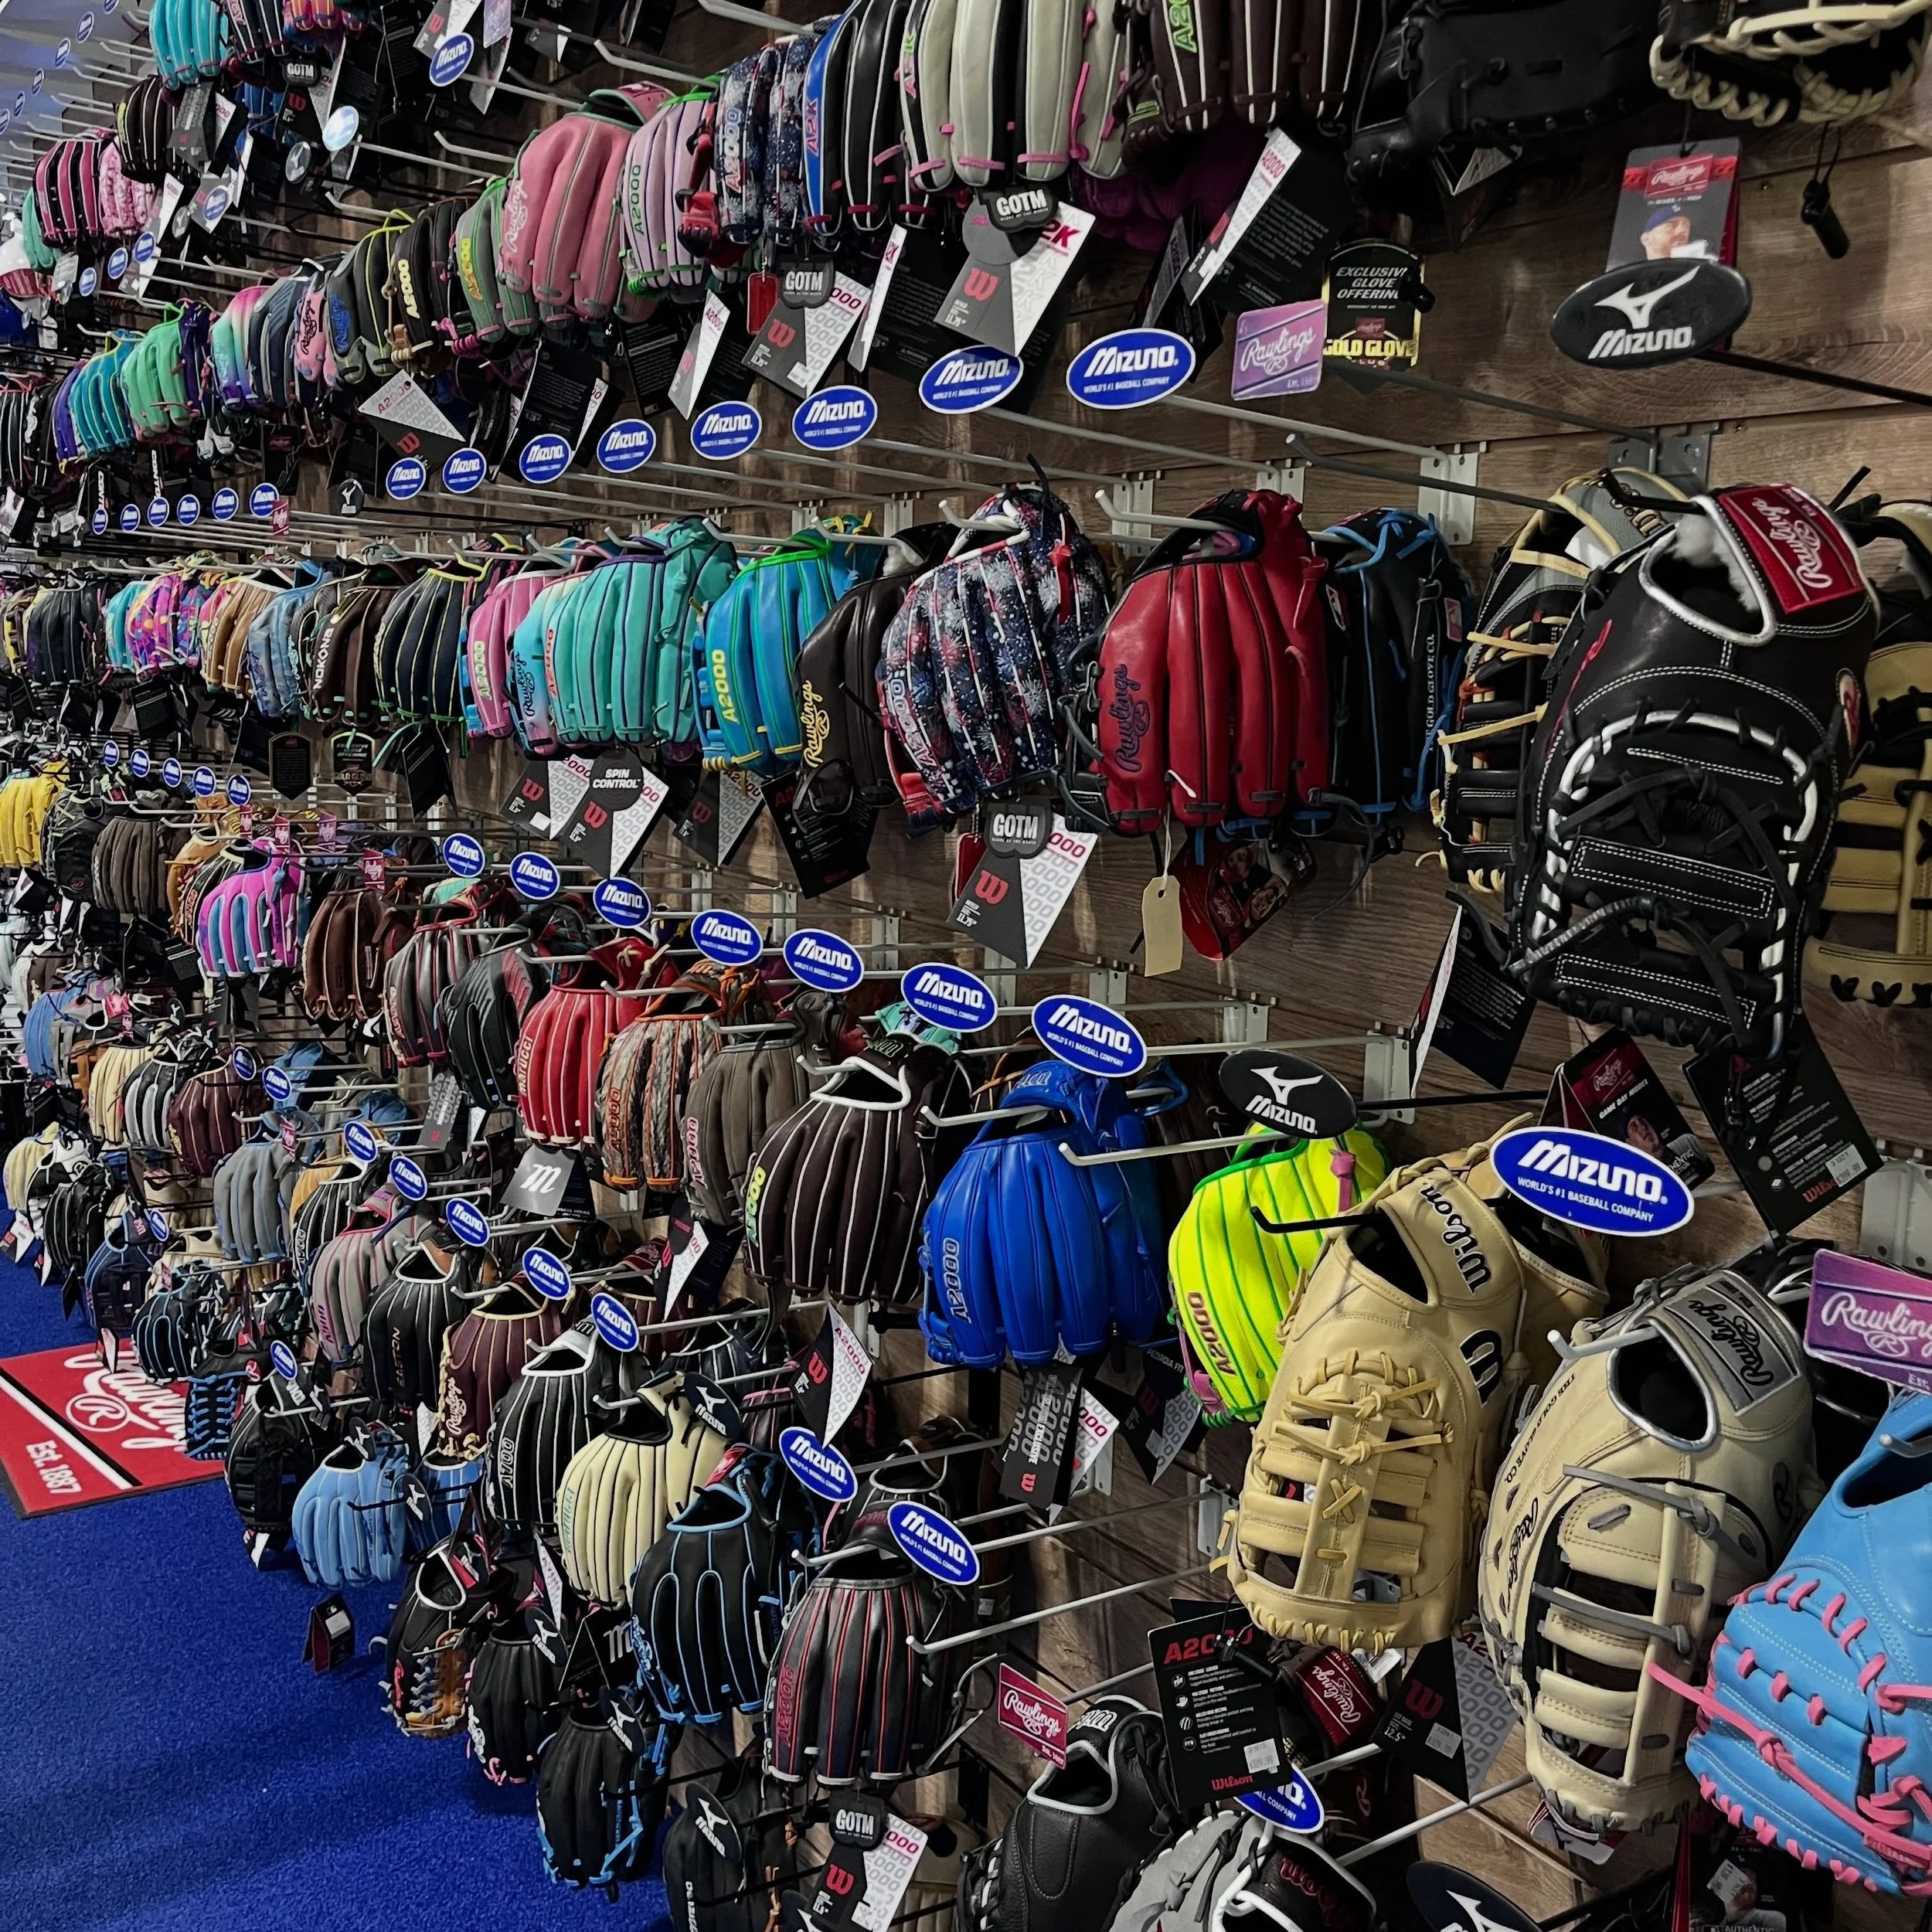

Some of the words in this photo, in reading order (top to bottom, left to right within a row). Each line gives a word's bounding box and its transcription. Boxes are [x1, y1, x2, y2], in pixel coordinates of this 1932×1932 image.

[287, 63, 314, 77] GOTM
[806, 96, 821, 157] A2K
[723, 107, 743, 192] A2000
[1260, 148, 1286, 179] A2000
[628, 163, 646, 236] A2000
[995, 189, 1048, 217] GOTM
[1041, 219, 1082, 249] 2K
[784, 270, 824, 291] GOTM
[1352, 277, 1397, 288] GLOVE
[1240, 327, 1317, 372] Rawlings
[1588, 326, 1696, 359] MIZUNO
[934, 358, 1010, 386] MIZUNO
[1083, 345, 1179, 379] MIZUNO
[376, 382, 413, 414] A2000
[804, 400, 867, 424] MIZUNO
[1753, 496, 1833, 590] Rawlings
[314, 626, 335, 691] NOKONA
[1426, 633, 1435, 654] CO.
[711, 649, 741, 723] A2000
[1426, 655, 1435, 695] GLOVE
[801, 679, 823, 768] Rawlings
[1108, 663, 1145, 774] Rawlings
[1425, 695, 1435, 728] GOLD
[563, 756, 591, 779] 2000
[592, 778, 641, 789] CONTROL
[605, 768, 630, 779] SPIN
[992, 812, 1039, 839] GOTM
[794, 937, 854, 971] MIZUNO
[913, 970, 986, 1010] MIZUNO
[1047, 1003, 1133, 1055] MIZUNO
[1245, 1094, 1318, 1135] MIZUNO
[1598, 1103, 1616, 1120] GAME
[1616, 1094, 1629, 1107] DAY
[1628, 1079, 1649, 1099] MODEL
[1517, 1139, 1668, 1206] MIZUNO
[1801, 1179, 1837, 1203] Wils
[1518, 1176, 1555, 1196] WORLD'S
[1555, 1187, 1566, 1199] #1
[1567, 1190, 1610, 1211] BASEBALL
[1611, 1202, 1655, 1223] COMPANY
[1418, 1182, 1494, 1296] Wilson
[942, 1236, 971, 1324] A2000
[835, 1327, 866, 1375] A2000
[1188, 1291, 1238, 1376] A2000
[1688, 1299, 1774, 1387] Rawlings
[1146, 1348, 1175, 1371] PEDROIA
[1174, 1362, 1185, 1375] FIT
[1536, 1393, 1559, 1428] GOLD
[502, 1437, 515, 1488] A700
[1028, 1423, 1045, 1465] EXCLUSIVE
[1515, 1427, 1539, 1469] GLOVE
[39, 1464, 83, 1495] 1887
[900, 1510, 968, 1566] MIZUNO
[1163, 1628, 1254, 1665] A20
[1311, 1665, 1362, 1724] Rawlings
[1003, 1689, 1063, 1740] Rawlings
[1383, 1725, 1406, 1743] 12.5"
[1211, 1775, 1253, 1791] Wilson
[835, 1808, 875, 1835] GOTM
[1267, 1794, 1298, 1821] COMPANY
[885, 1830, 920, 1855] 000
